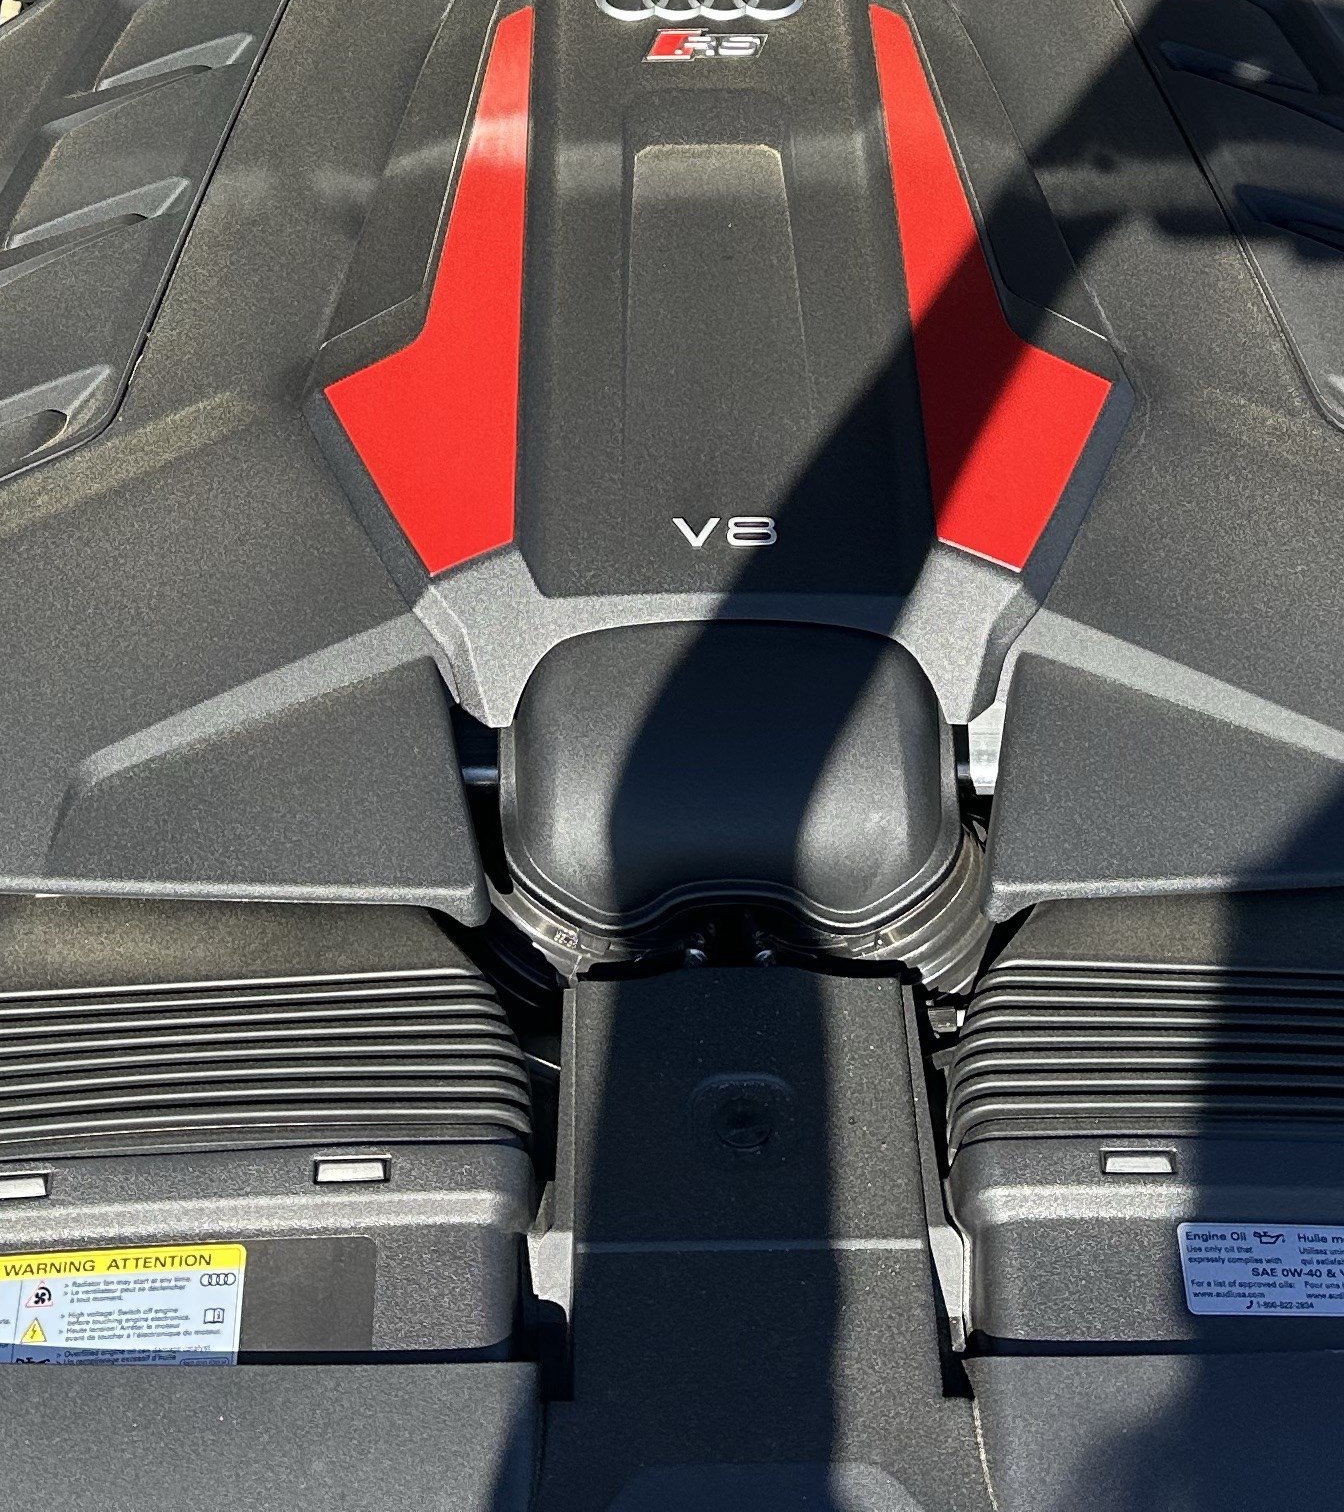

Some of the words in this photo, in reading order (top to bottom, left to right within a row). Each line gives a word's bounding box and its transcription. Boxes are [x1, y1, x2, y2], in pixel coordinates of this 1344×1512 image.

[672, 516, 778, 548] V8
[1185, 1231, 1227, 1243] Engine
[1230, 1231, 1247, 1242] Oil
[1297, 1233, 1328, 1244] Huile
[1186, 1246, 1203, 1254] Use
[1204, 1245, 1223, 1255] only
[1224, 1245, 1236, 1253] oil
[1236, 1246, 1254, 1254] that
[4, 1261, 96, 1277] WARNING
[106, 1253, 212, 1271] ATTENTION
[1188, 1256, 1226, 1266] expressly
[1227, 1256, 1264, 1266] complies
[1264, 1256, 1283, 1265] with
[1300, 1258, 1315, 1267] qui
[1251, 1267, 1279, 1278] SAE
[1281, 1268, 1323, 1278] 0W-40
[1326, 1268, 1337, 1278] &
[133, 1277, 150, 1285] start
[1190, 1278, 1206, 1288] For
[1213, 1279, 1227, 1288] list
[1228, 1278, 1238, 1287] of
[1238, 1279, 1278, 1289] approved
[67, 1311, 84, 1321] High
[142, 1306, 154, 1315] off
[154, 1306, 179, 1316] engine
[91, 1316, 123, 1327] touching
[124, 1315, 149, 1325] engine
